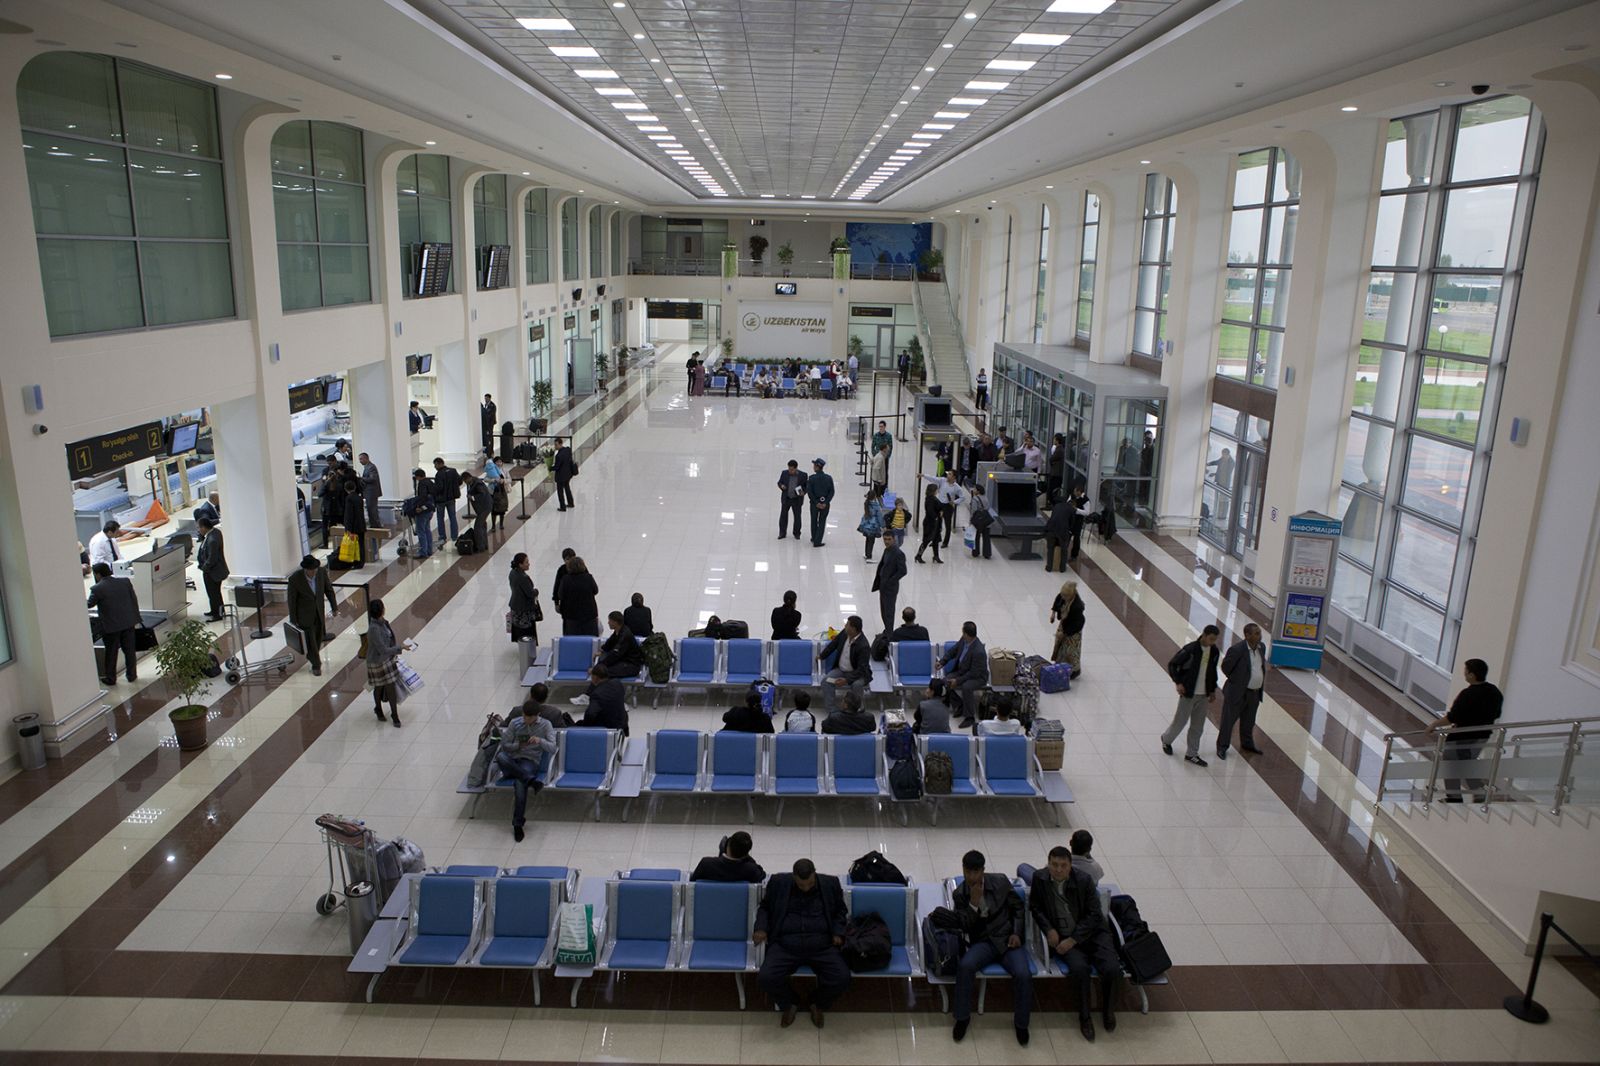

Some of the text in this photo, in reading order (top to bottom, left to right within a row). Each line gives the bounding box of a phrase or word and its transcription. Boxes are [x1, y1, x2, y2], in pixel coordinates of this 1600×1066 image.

[763, 316, 826, 327] UZBEKISTAN
[151, 432, 158, 447] 2
[80, 450, 87, 467] 1
[1290, 524, 1340, 534] ИНФОРМАЦИЯ
